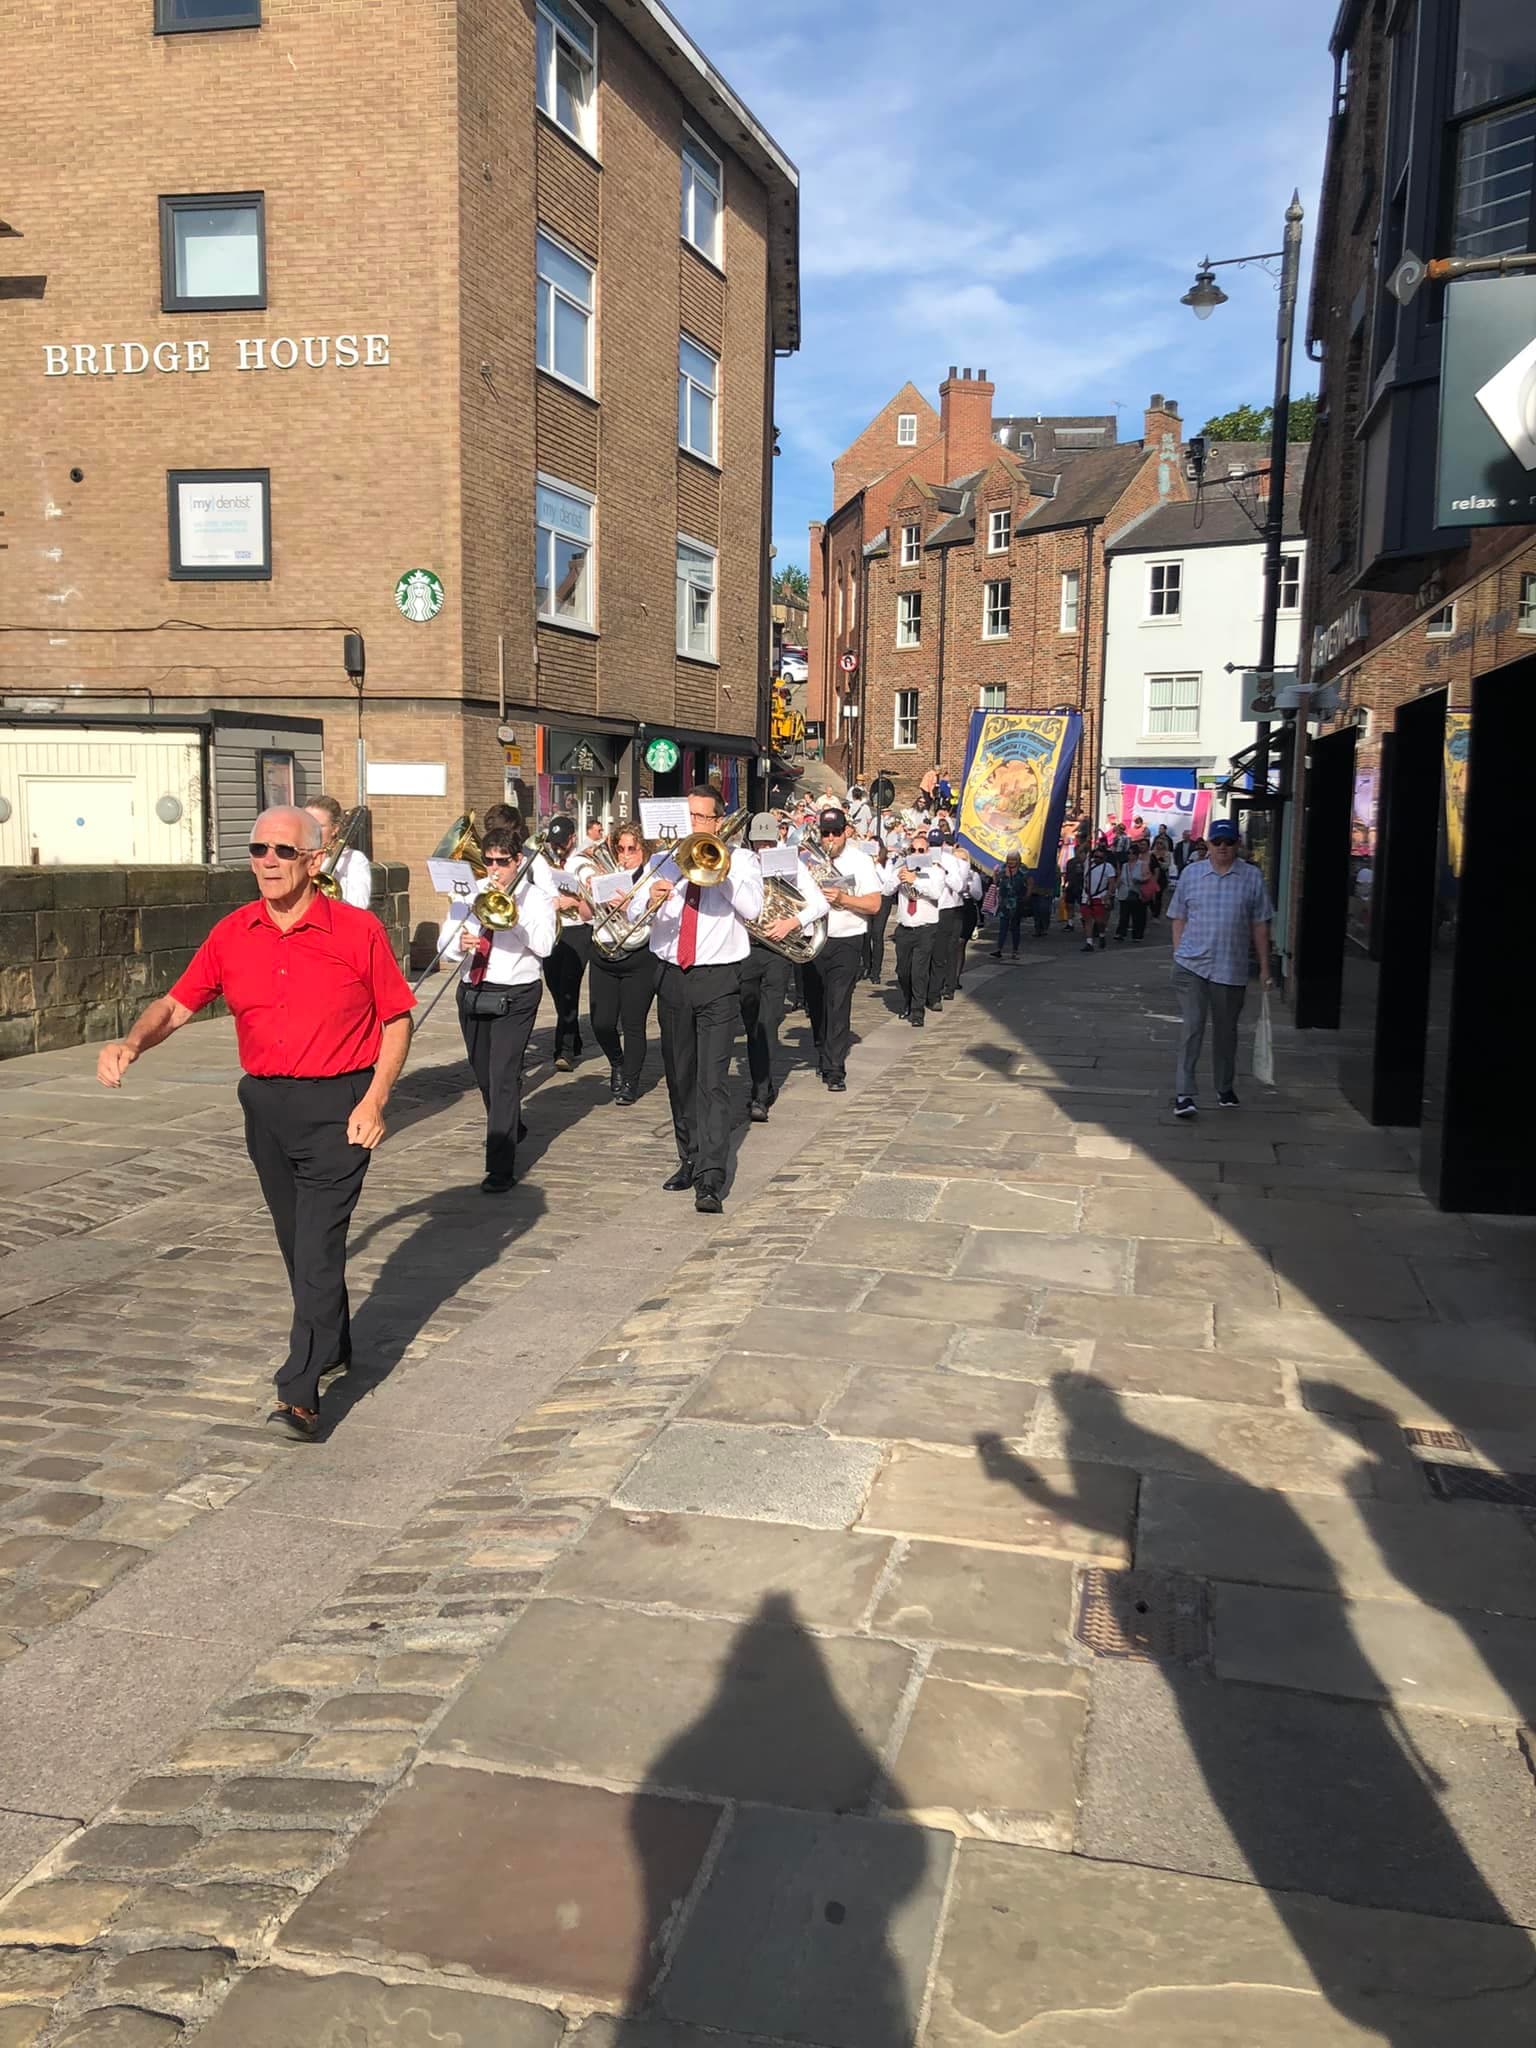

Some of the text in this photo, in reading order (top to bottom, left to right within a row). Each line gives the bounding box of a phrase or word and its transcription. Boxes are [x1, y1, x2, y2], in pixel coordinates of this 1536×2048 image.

[43, 334, 391, 377] BRIDGE HOUSE
[1451, 495, 1497, 511] relax
[1137, 788, 1196, 812] UCU
